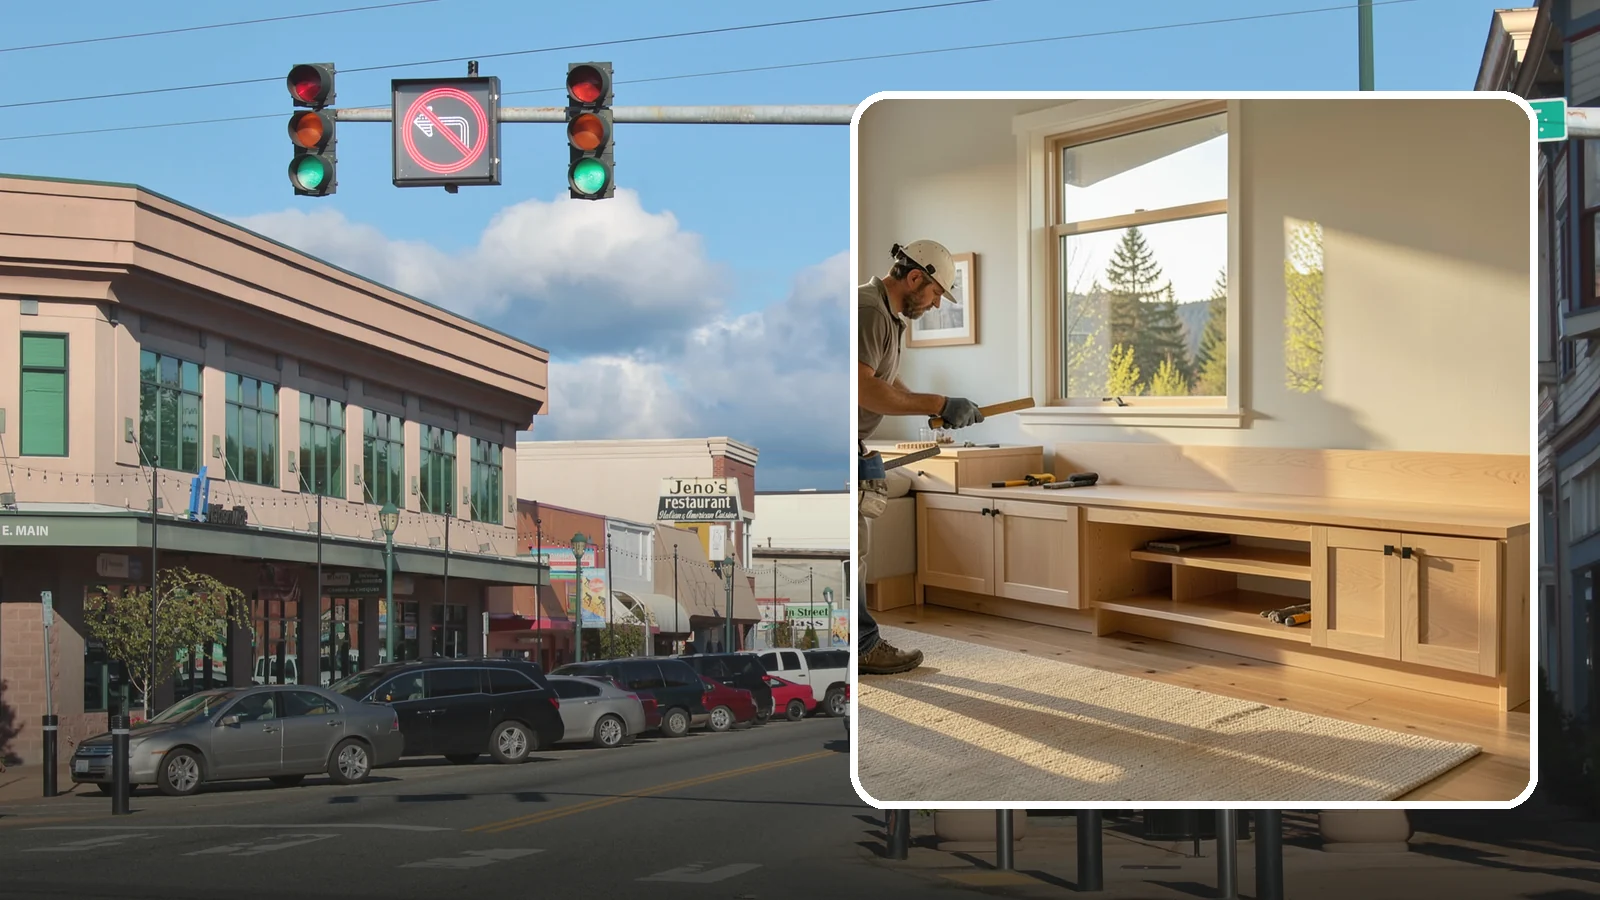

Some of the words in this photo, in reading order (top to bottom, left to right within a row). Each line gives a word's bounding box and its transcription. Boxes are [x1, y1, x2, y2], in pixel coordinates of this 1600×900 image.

[669, 480, 728, 495] Jeno's
[665, 496, 731, 509] restaurant
[685, 510, 715, 519] American
[714, 509, 738, 519] Cuisine
[2, 525, 13, 536] E.
[15, 525, 49, 537] MAIN
[797, 607, 828, 617] Street
[790, 619, 823, 627] lass
